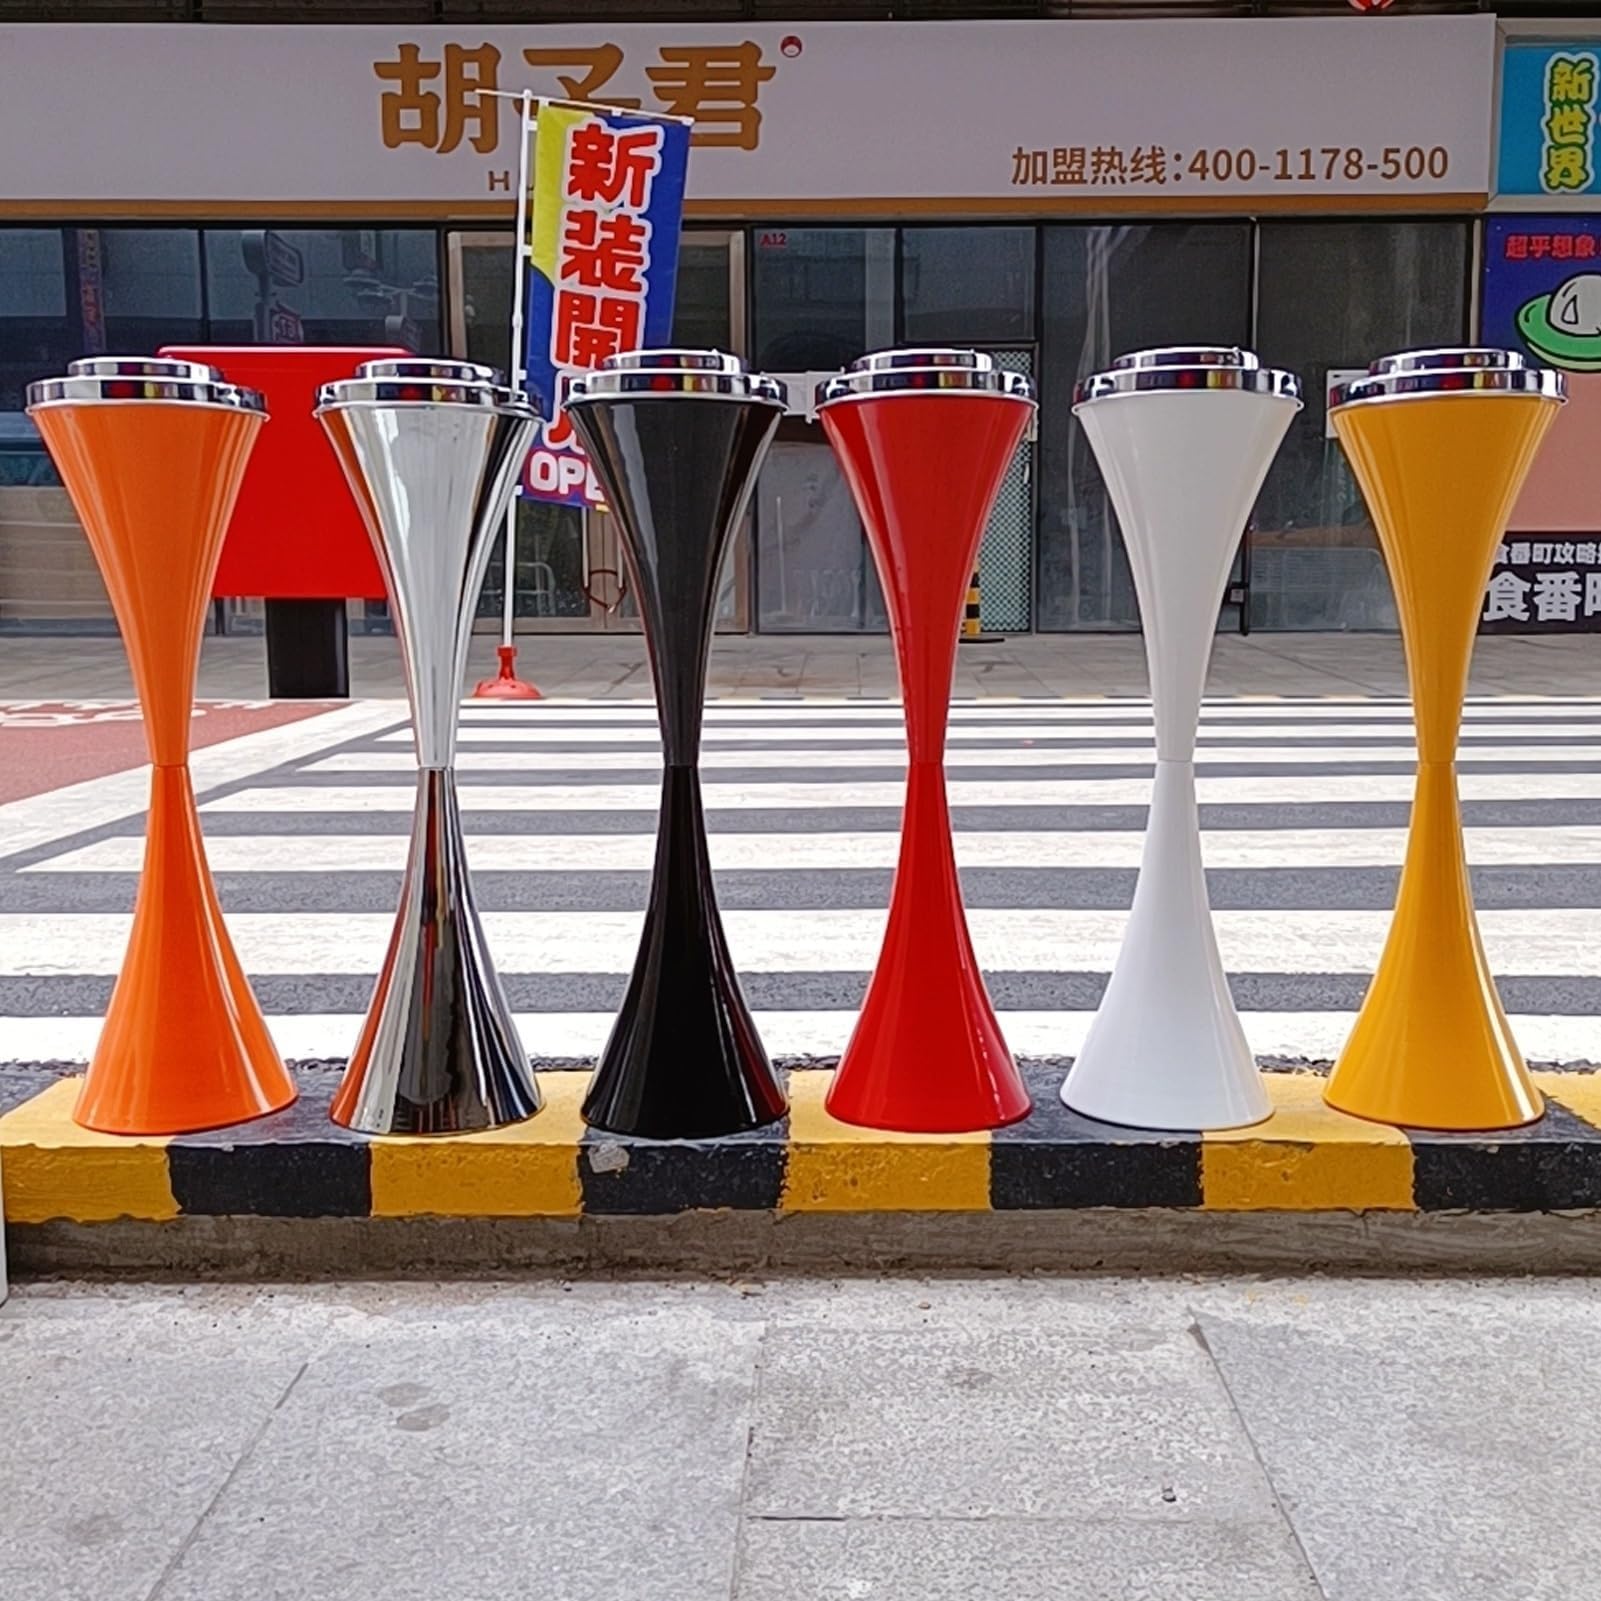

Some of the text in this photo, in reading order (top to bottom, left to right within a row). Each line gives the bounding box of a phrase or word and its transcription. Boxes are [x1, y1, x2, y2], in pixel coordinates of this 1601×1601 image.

[1545, 57, 1594, 190] 新世界
[548, 122, 658, 443] 新装開
[761, 233, 786, 247] A12
